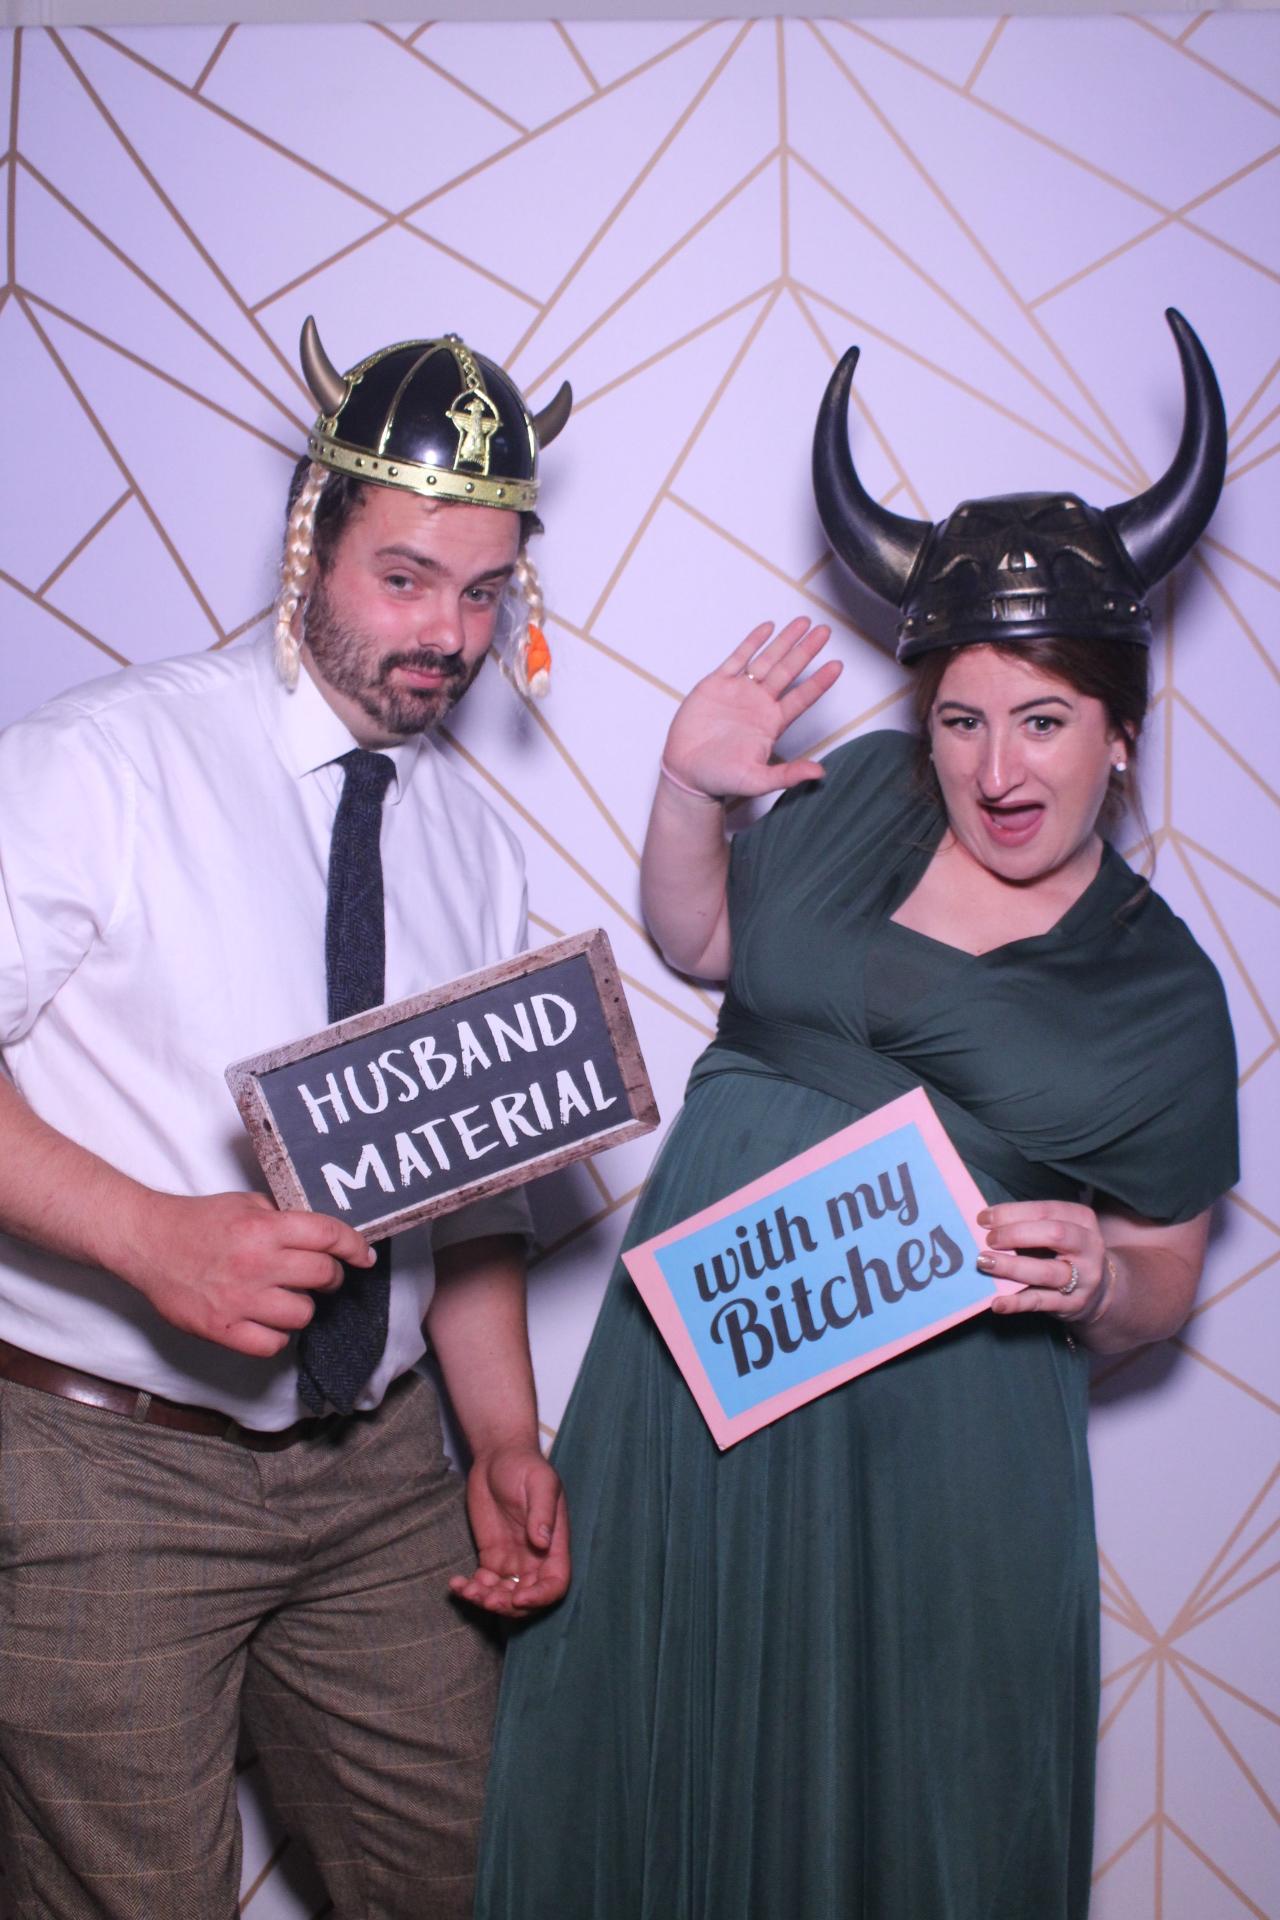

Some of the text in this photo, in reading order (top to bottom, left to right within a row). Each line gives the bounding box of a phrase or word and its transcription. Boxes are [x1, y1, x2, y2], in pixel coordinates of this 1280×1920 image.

[297, 993, 577, 1134] HUSBAND
[320, 1059, 617, 1210] MATERIAL
[693, 1161, 920, 1302] with my
[709, 1224, 965, 1378] Bitches
